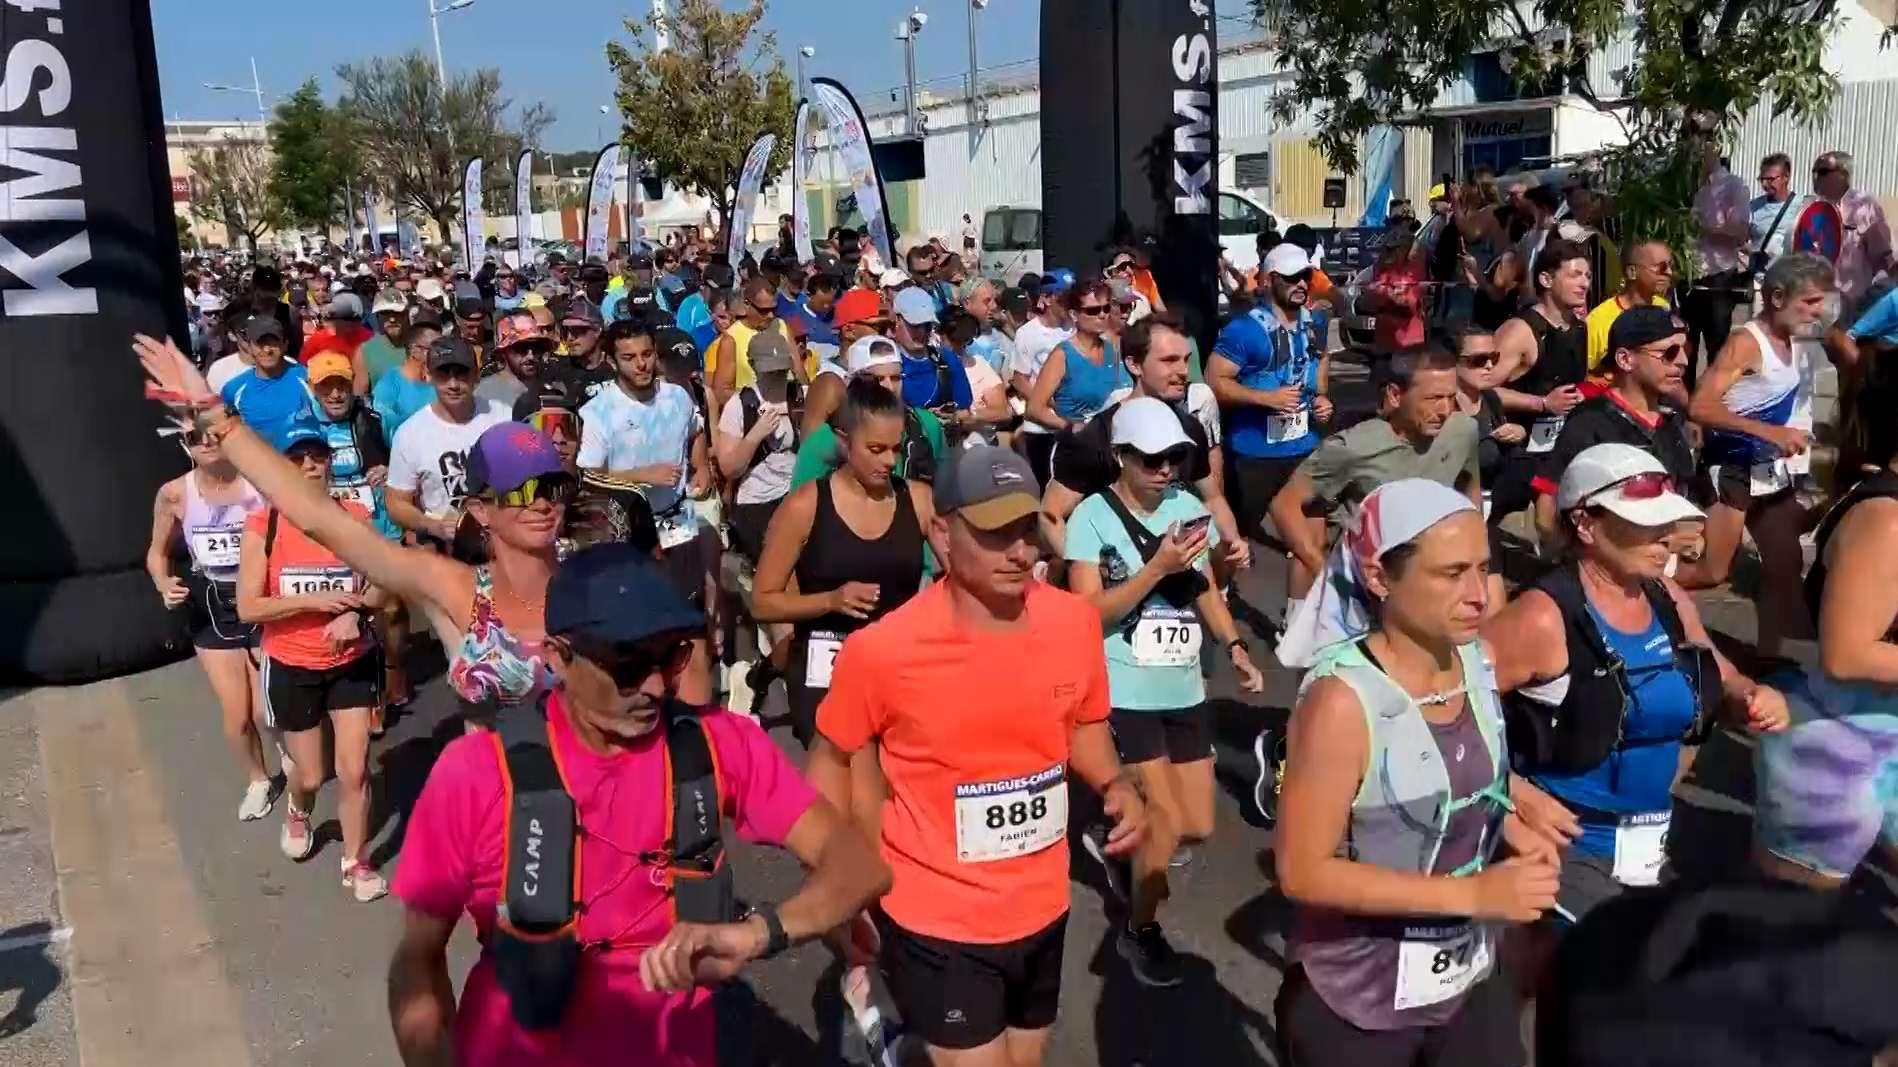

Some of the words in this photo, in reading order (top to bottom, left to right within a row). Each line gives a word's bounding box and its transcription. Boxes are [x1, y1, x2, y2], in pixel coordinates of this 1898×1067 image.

[1152, 626, 1190, 644] 170
[986, 796, 1047, 829] 888
[523, 819, 544, 896] CAMP
